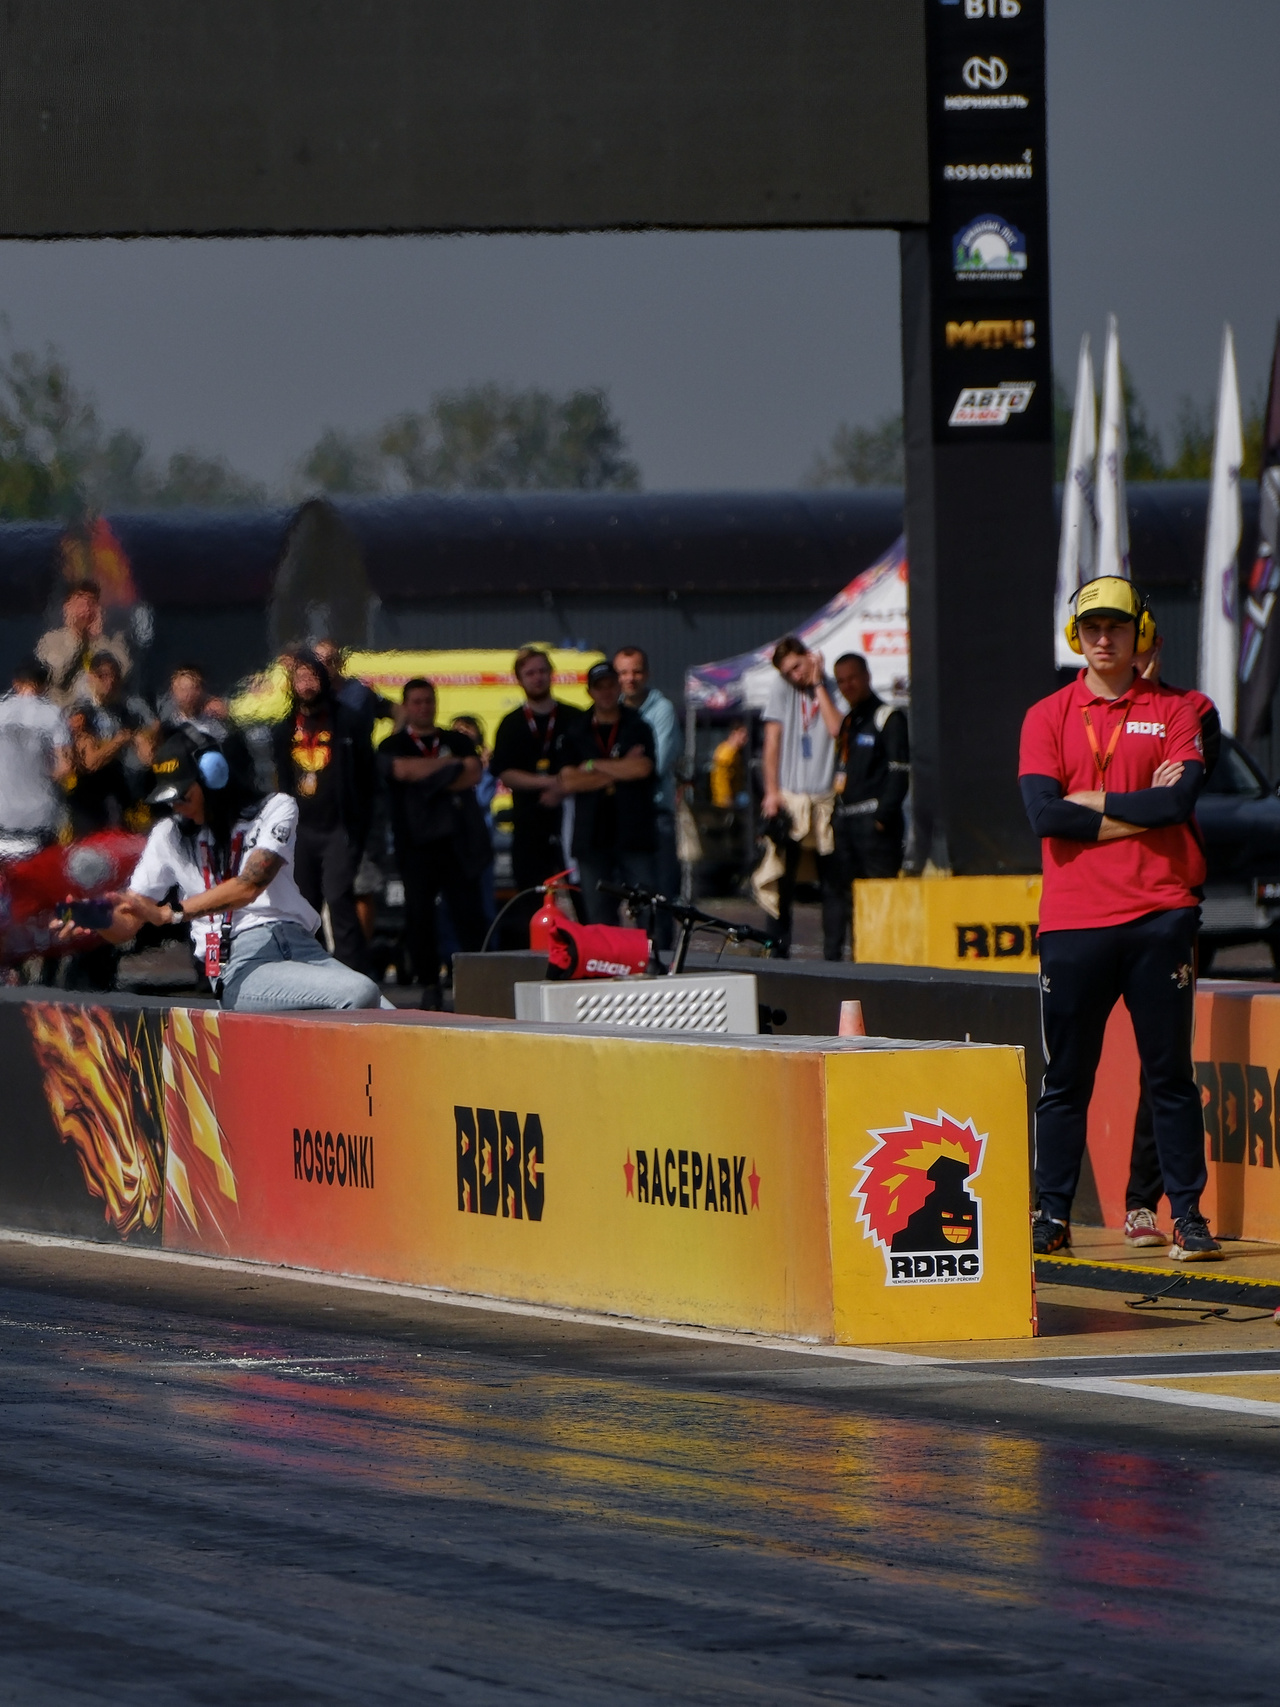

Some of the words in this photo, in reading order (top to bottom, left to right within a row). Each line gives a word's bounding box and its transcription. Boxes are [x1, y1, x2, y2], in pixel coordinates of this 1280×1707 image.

[1193, 1062, 1280, 1168] RDR
[293, 1128, 374, 1189] ROSGONKI
[454, 1105, 544, 1222] RDRC
[636, 1148, 748, 1215] RACEPARK
[890, 1254, 979, 1278] RDRC
